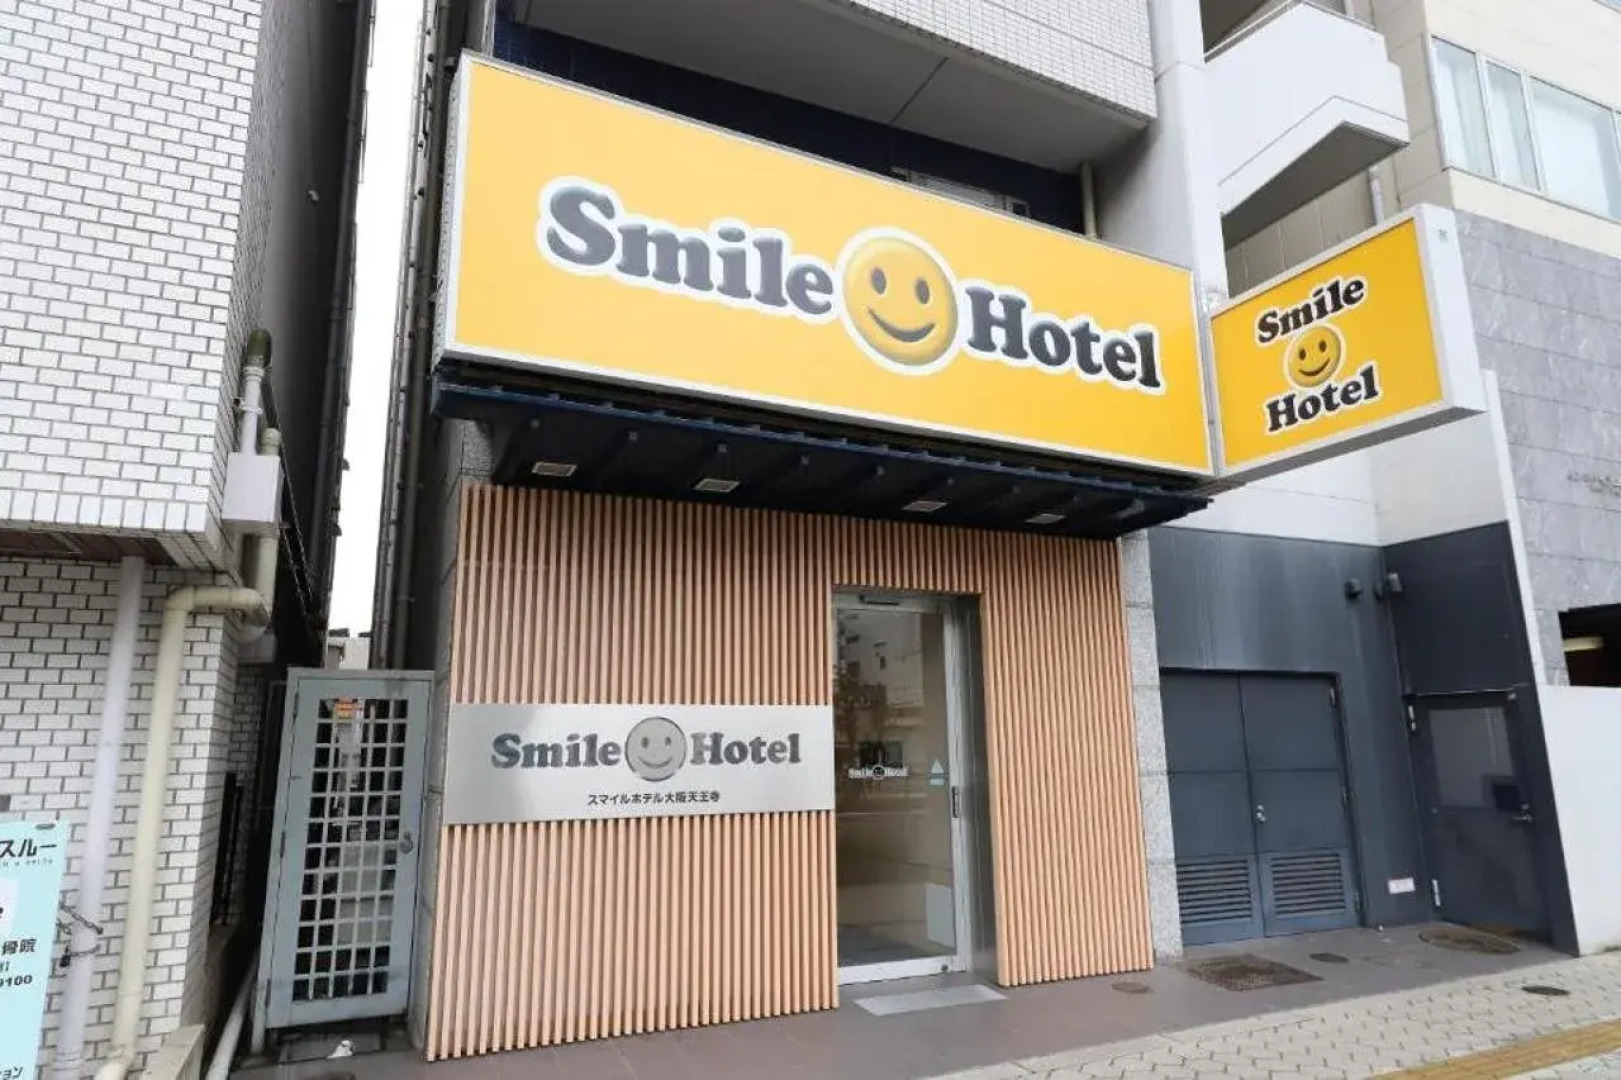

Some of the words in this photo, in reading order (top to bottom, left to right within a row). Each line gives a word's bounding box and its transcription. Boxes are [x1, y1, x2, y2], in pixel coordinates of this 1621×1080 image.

[547, 186, 834, 315] Smile
[964, 286, 1161, 388] Hotel
[1258, 279, 1365, 343] Smile
[1266, 364, 1379, 432] Hotel
[490, 732, 622, 769] Smile
[690, 732, 802, 765] Hotel
[587, 790, 721, 806] スマイルホテル大阪天王寺
